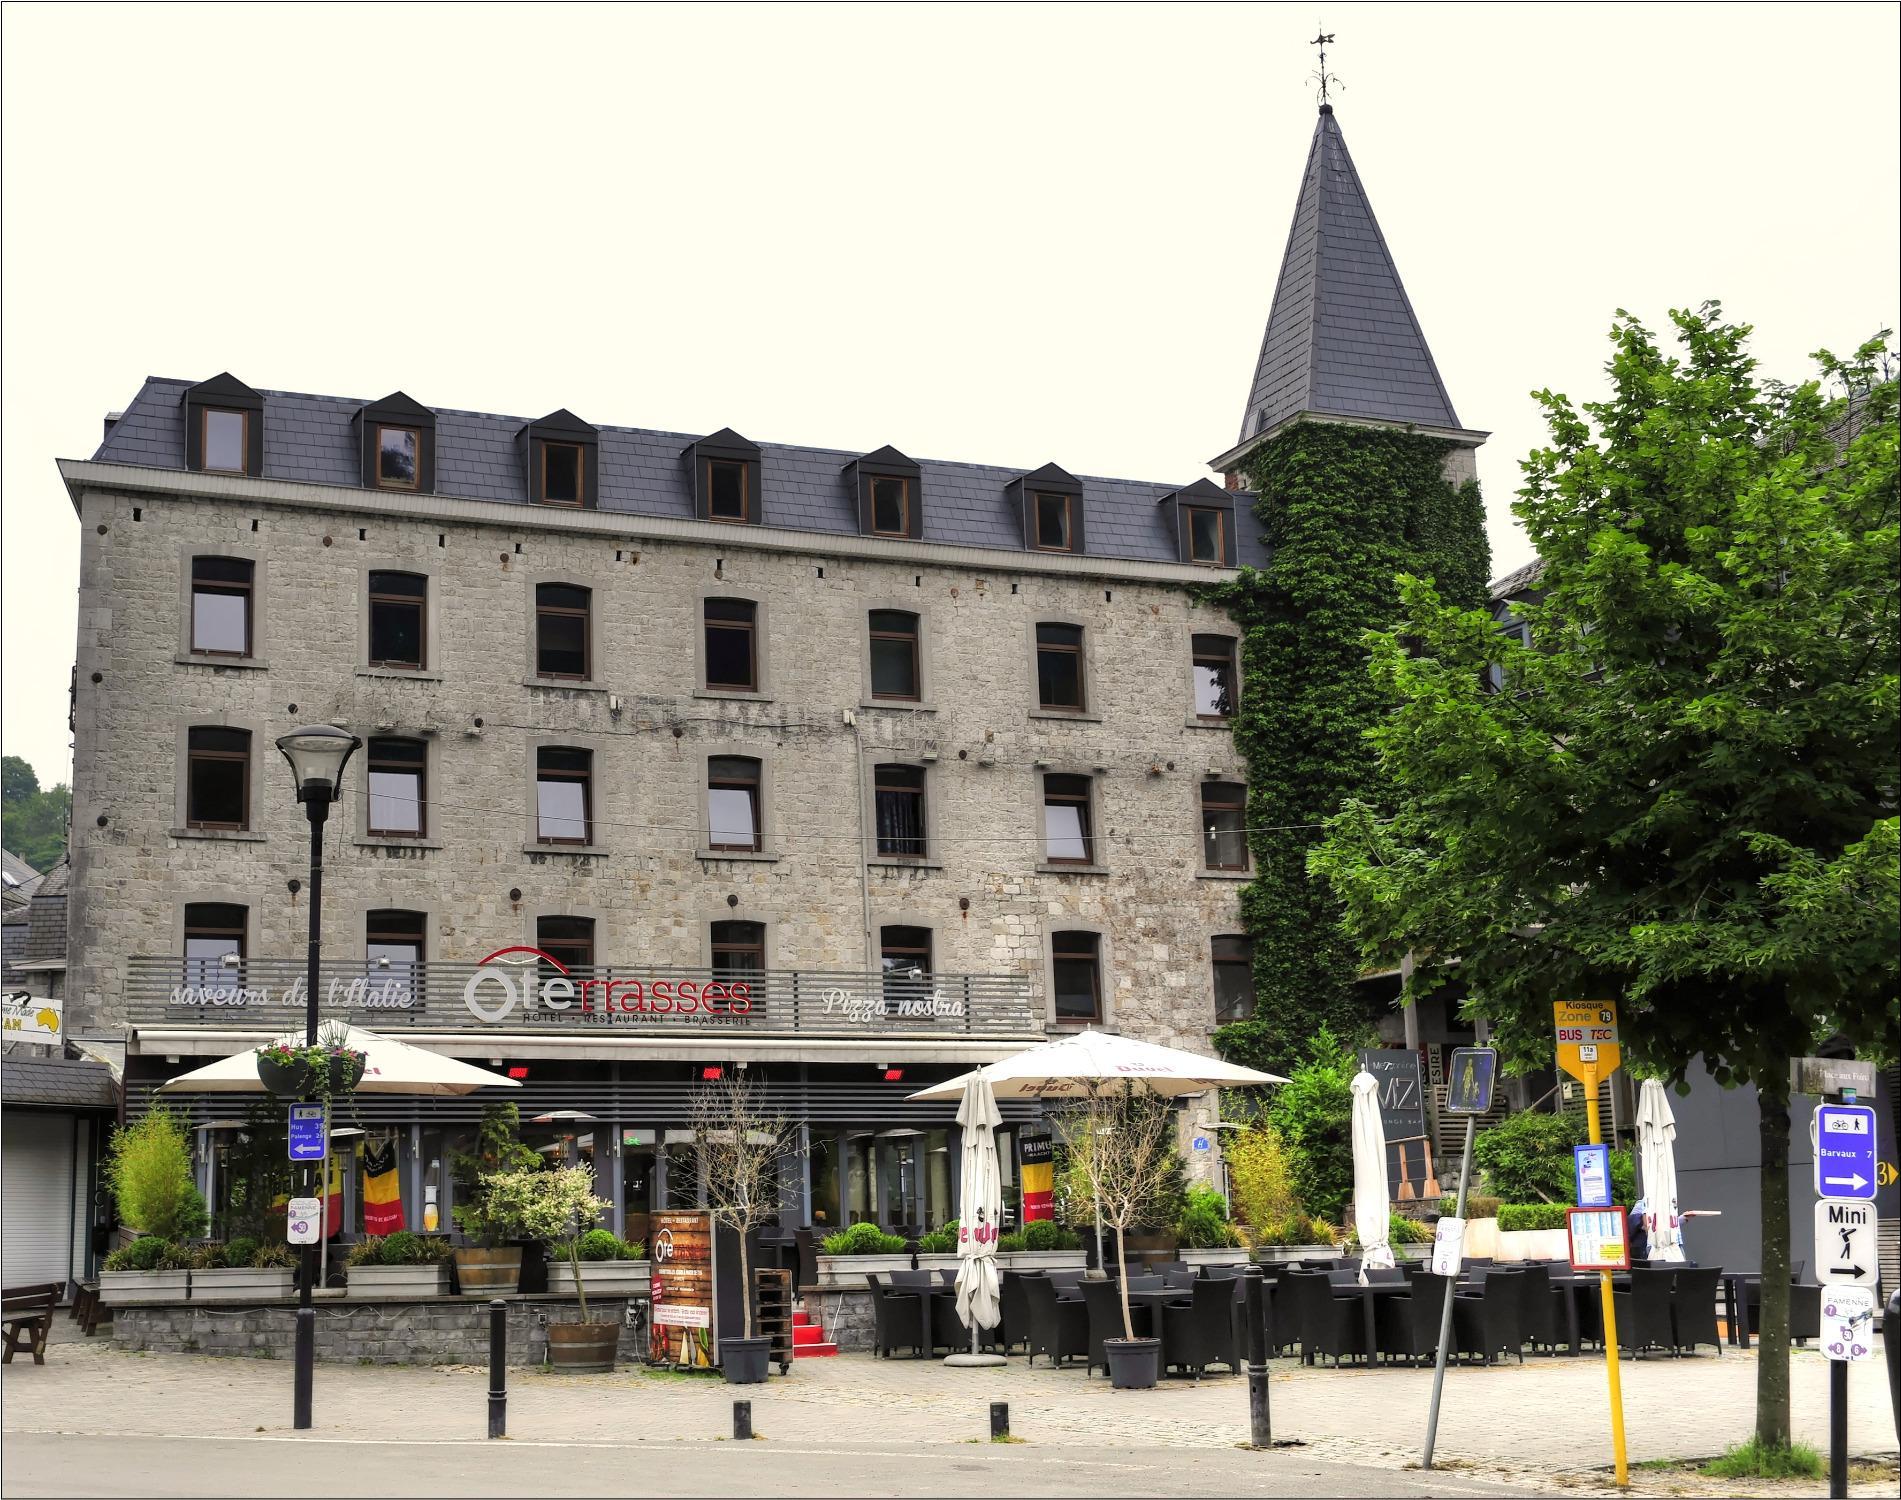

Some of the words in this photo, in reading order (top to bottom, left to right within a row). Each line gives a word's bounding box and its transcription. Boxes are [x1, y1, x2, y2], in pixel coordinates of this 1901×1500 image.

[169, 986, 271, 1006] saveurs
[282, 977, 308, 1008] de
[328, 977, 417, 1009] l'Italie
[821, 988, 888, 1022] Pizza
[899, 989, 967, 1017] nostra
[1566, 1001, 1604, 1010] Kiosque
[584, 1013, 665, 1024] RESTAURANT
[684, 1015, 751, 1025] BRASSERIE
[1559, 1011, 1591, 1021] Zone
[1601, 1011, 1611, 1021] 79
[1559, 1030, 1583, 1040] BUS
[1590, 1029, 1612, 1039] TEC
[1430, 1047, 1441, 1085] ESIRE
[290, 1123, 304, 1132] Huy
[1024, 1141, 1053, 1153] PRIMU
[1820, 1148, 1857, 1158] Barvaux
[1866, 1151, 1873, 1159] 7
[1828, 1205, 1867, 1225] Mini
[1828, 1297, 1869, 1307] FAMENNE
